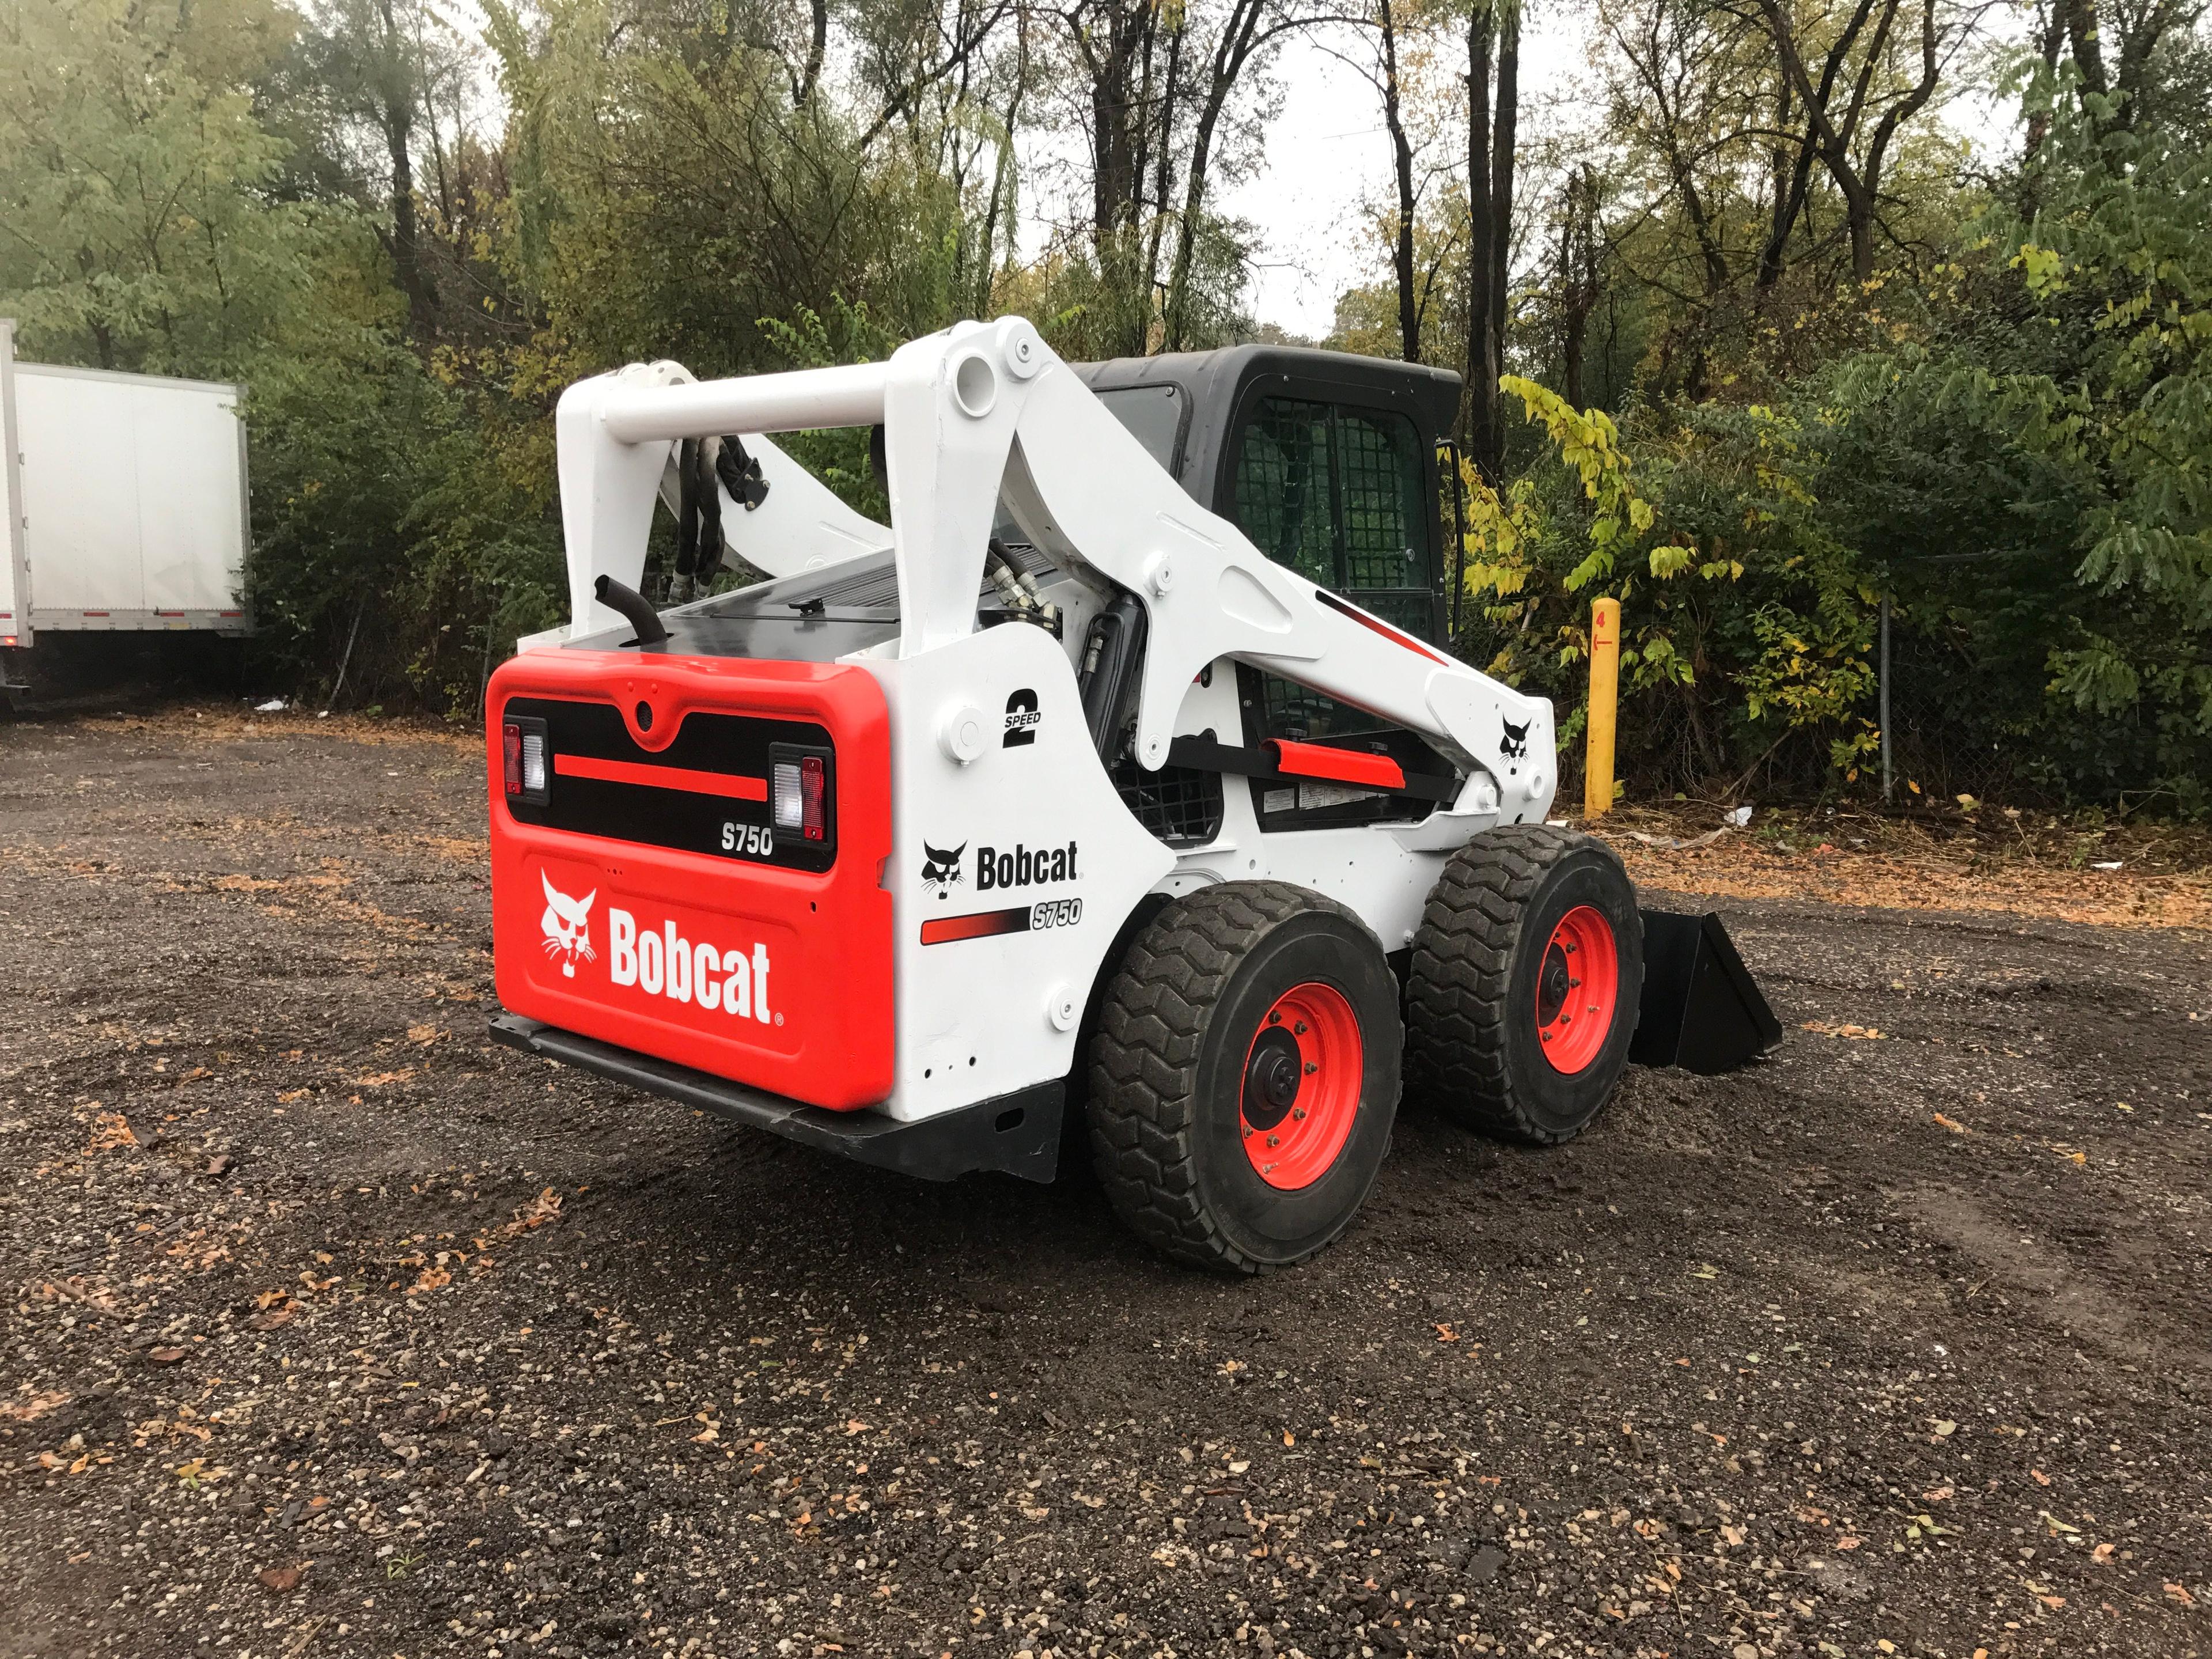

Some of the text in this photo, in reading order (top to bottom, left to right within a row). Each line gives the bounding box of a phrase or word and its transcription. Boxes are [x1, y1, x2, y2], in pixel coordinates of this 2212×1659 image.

[1596, 611, 1605, 628] 4
[1002, 688, 1038, 748] 2
[1005, 712, 1041, 728] SPEED
[722, 822, 772, 855] S750
[977, 841, 1077, 891] Bobcat
[1032, 897, 1082, 930] S750
[609, 907, 770, 1024] Bobcat
